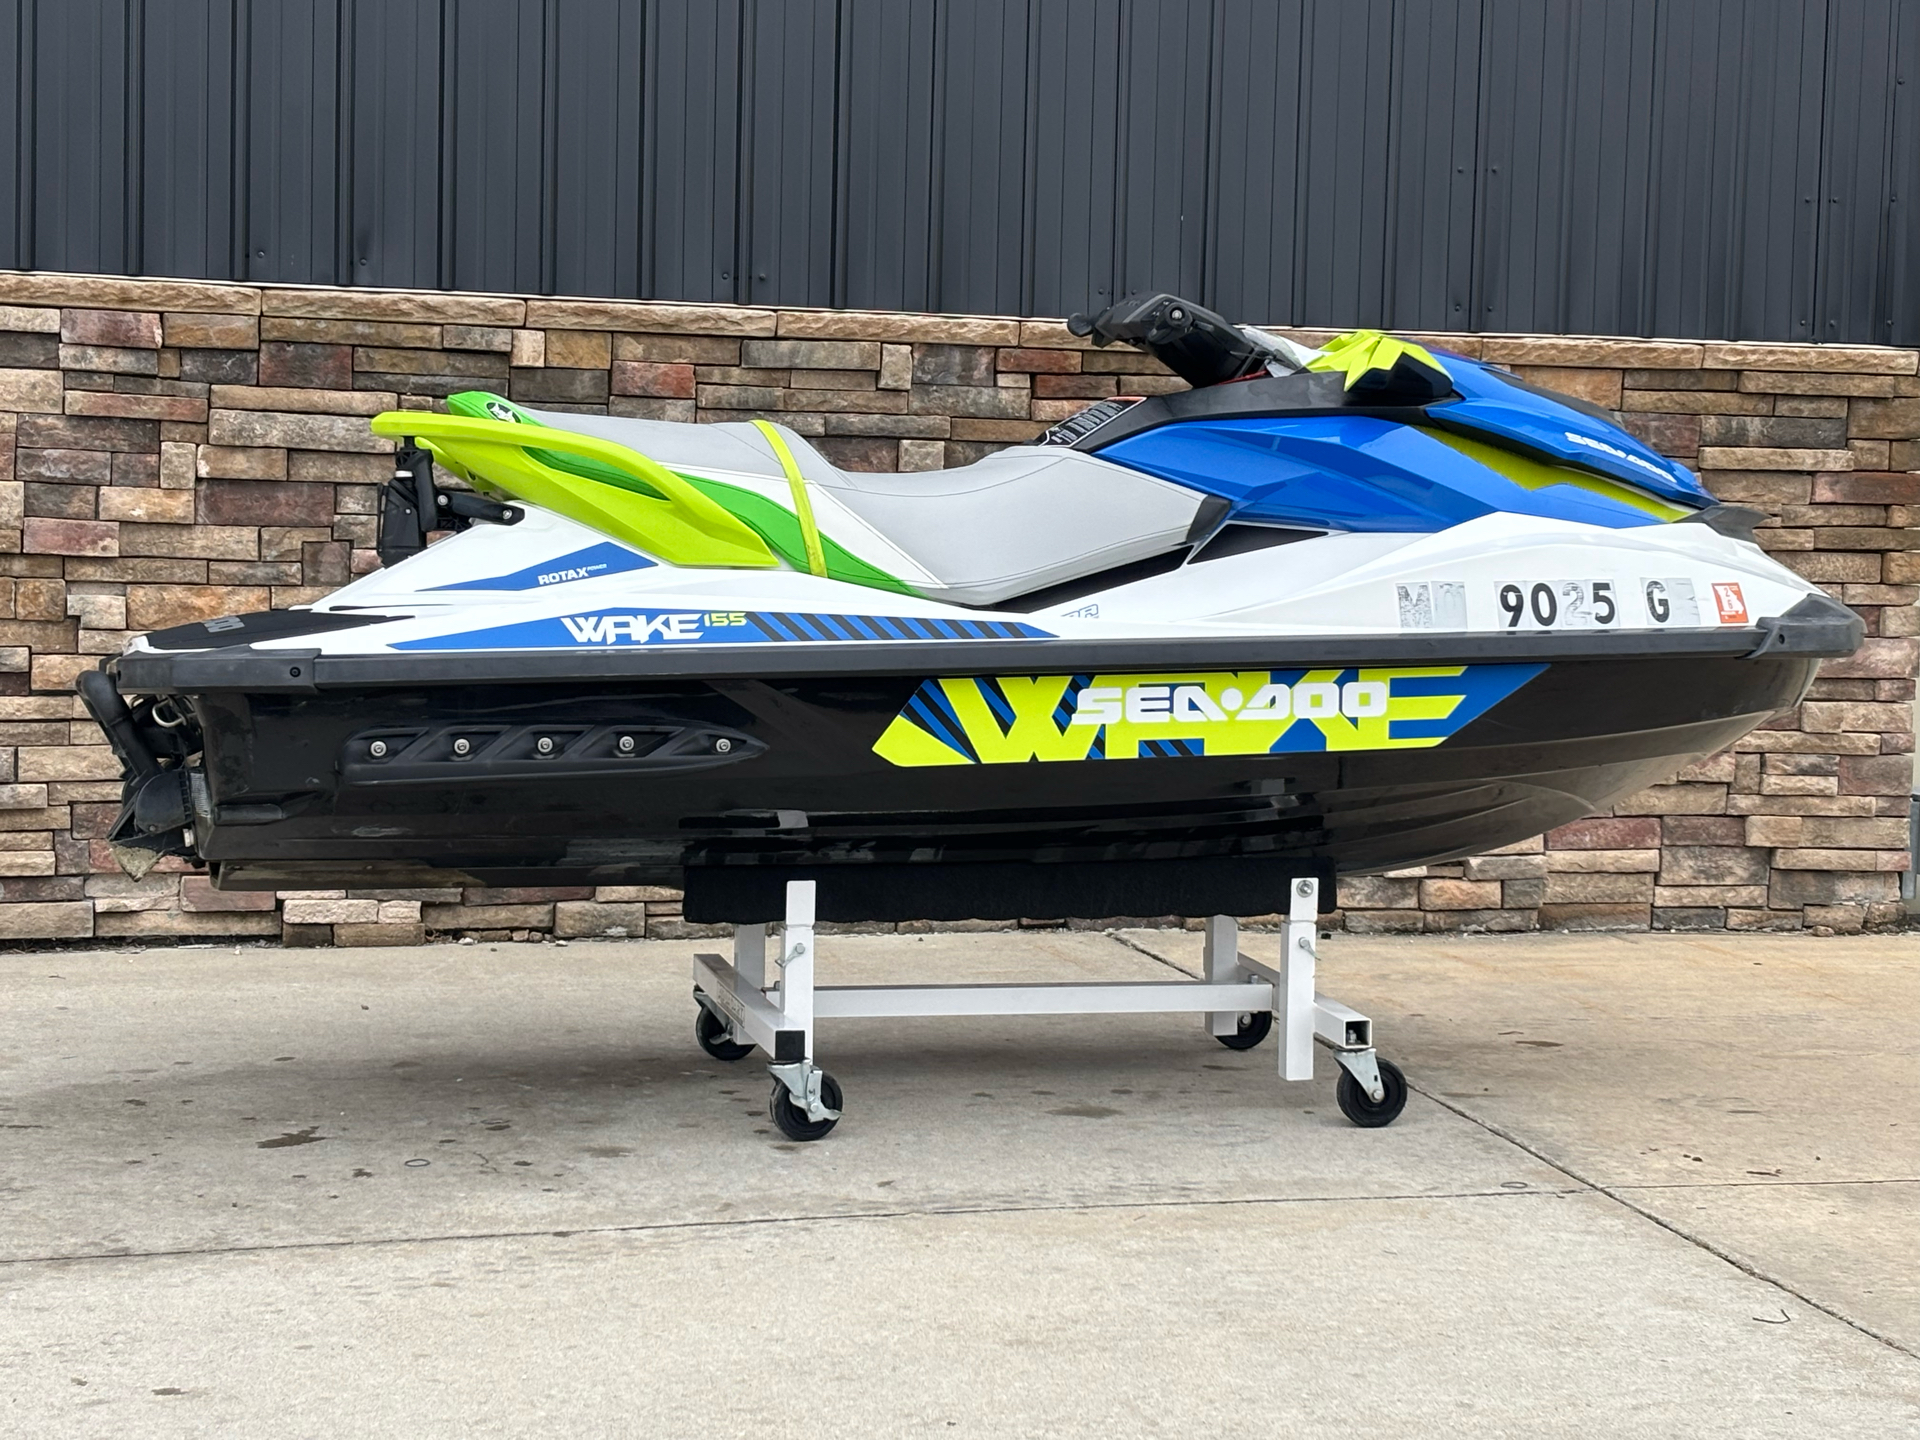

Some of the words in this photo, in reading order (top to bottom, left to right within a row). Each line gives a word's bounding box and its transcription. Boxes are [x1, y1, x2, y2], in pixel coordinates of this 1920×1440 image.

[538, 567, 589, 585] ROTAX
[1500, 582, 1615, 627] 9025
[560, 613, 704, 645] WAKE
[703, 612, 747, 627] 155
